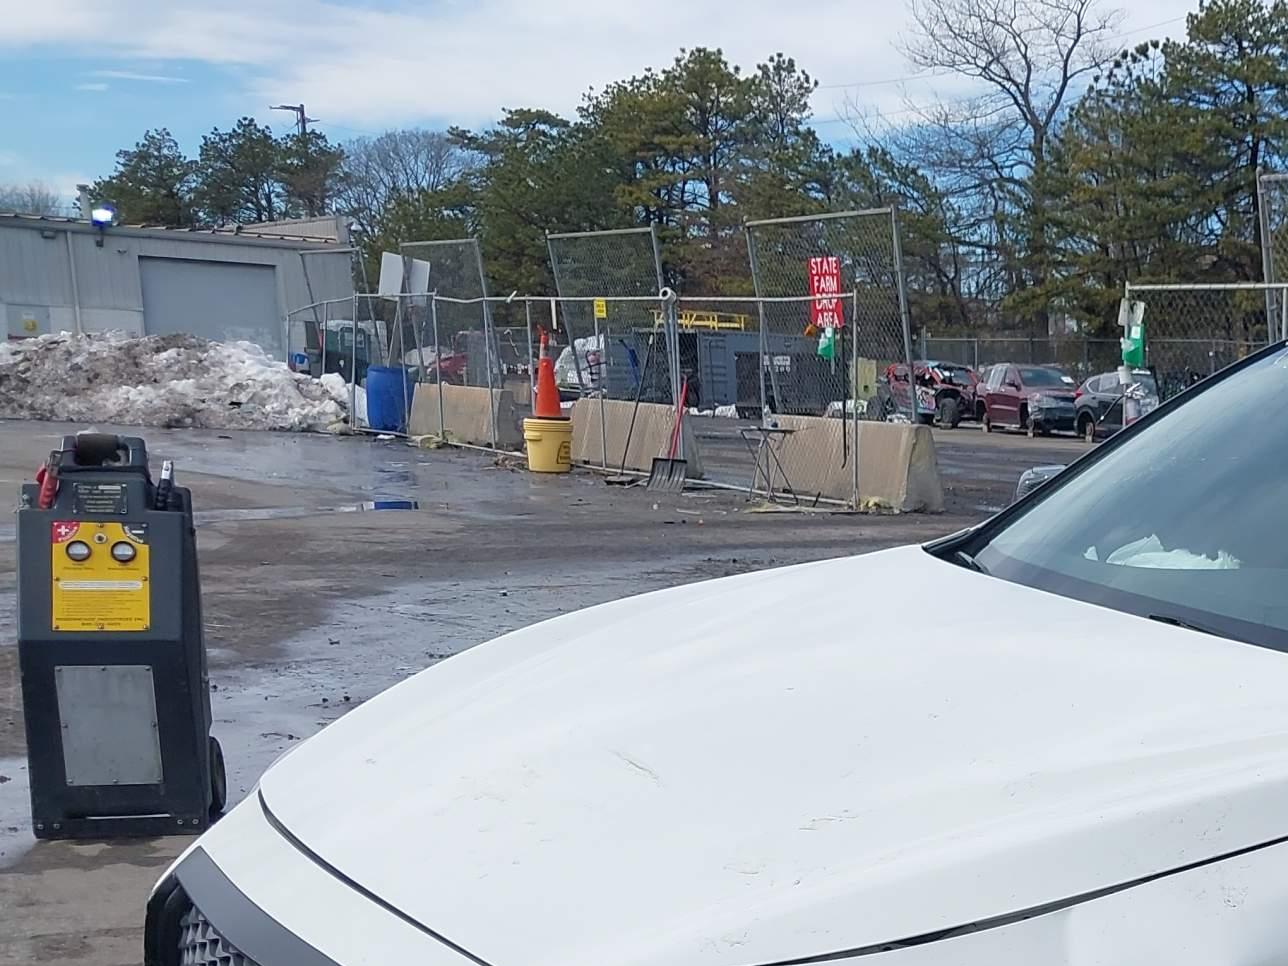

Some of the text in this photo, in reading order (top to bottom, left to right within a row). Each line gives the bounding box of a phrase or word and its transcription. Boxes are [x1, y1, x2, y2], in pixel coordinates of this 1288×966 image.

[811, 257, 838, 274] STATE
[814, 275, 838, 292] FARM
[817, 312, 841, 328] AREA
